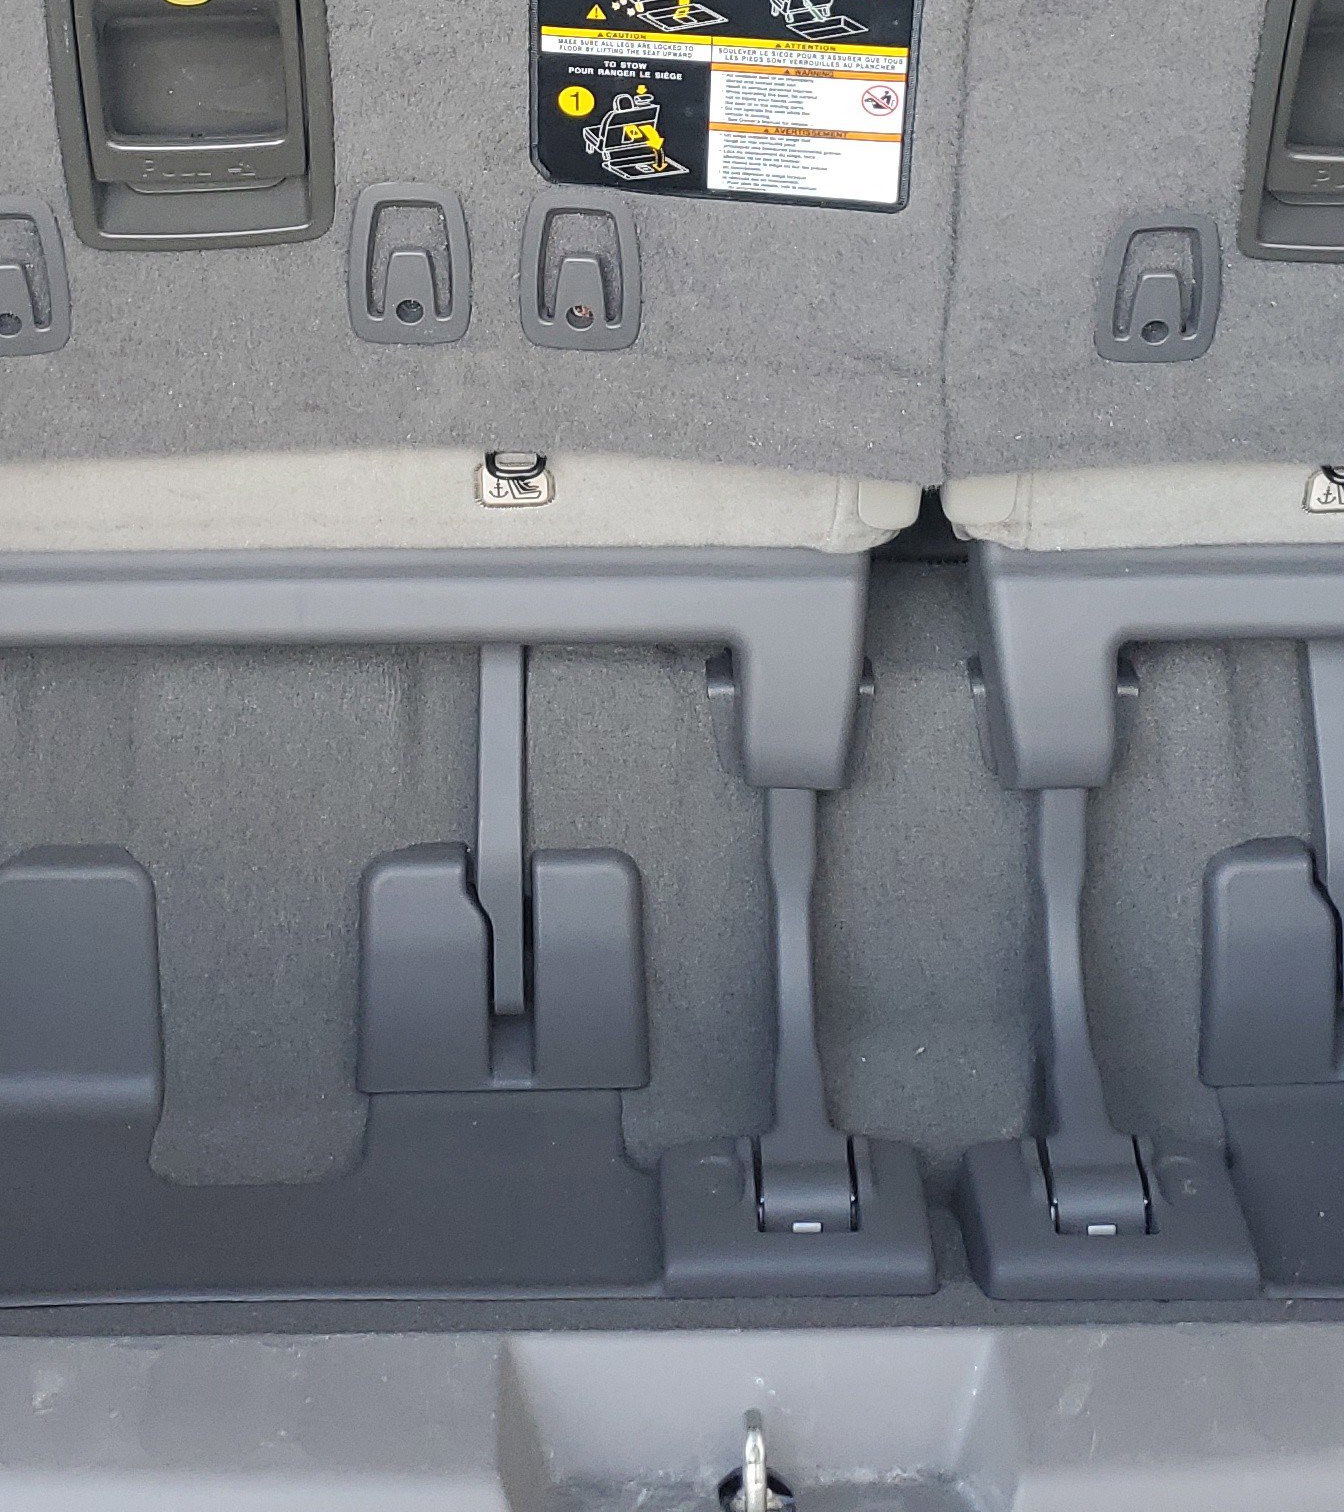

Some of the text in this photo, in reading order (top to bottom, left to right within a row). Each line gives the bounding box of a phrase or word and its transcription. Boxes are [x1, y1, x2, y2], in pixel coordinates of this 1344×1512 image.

[606, 32, 647, 40] CAUTION
[784, 43, 837, 51] ATTENTION
[620, 62, 647, 70] STOW
[568, 66, 594, 75] POUR
[597, 68, 636, 77] RANGER
[775, 128, 848, 138] AVERTISSEMENT
